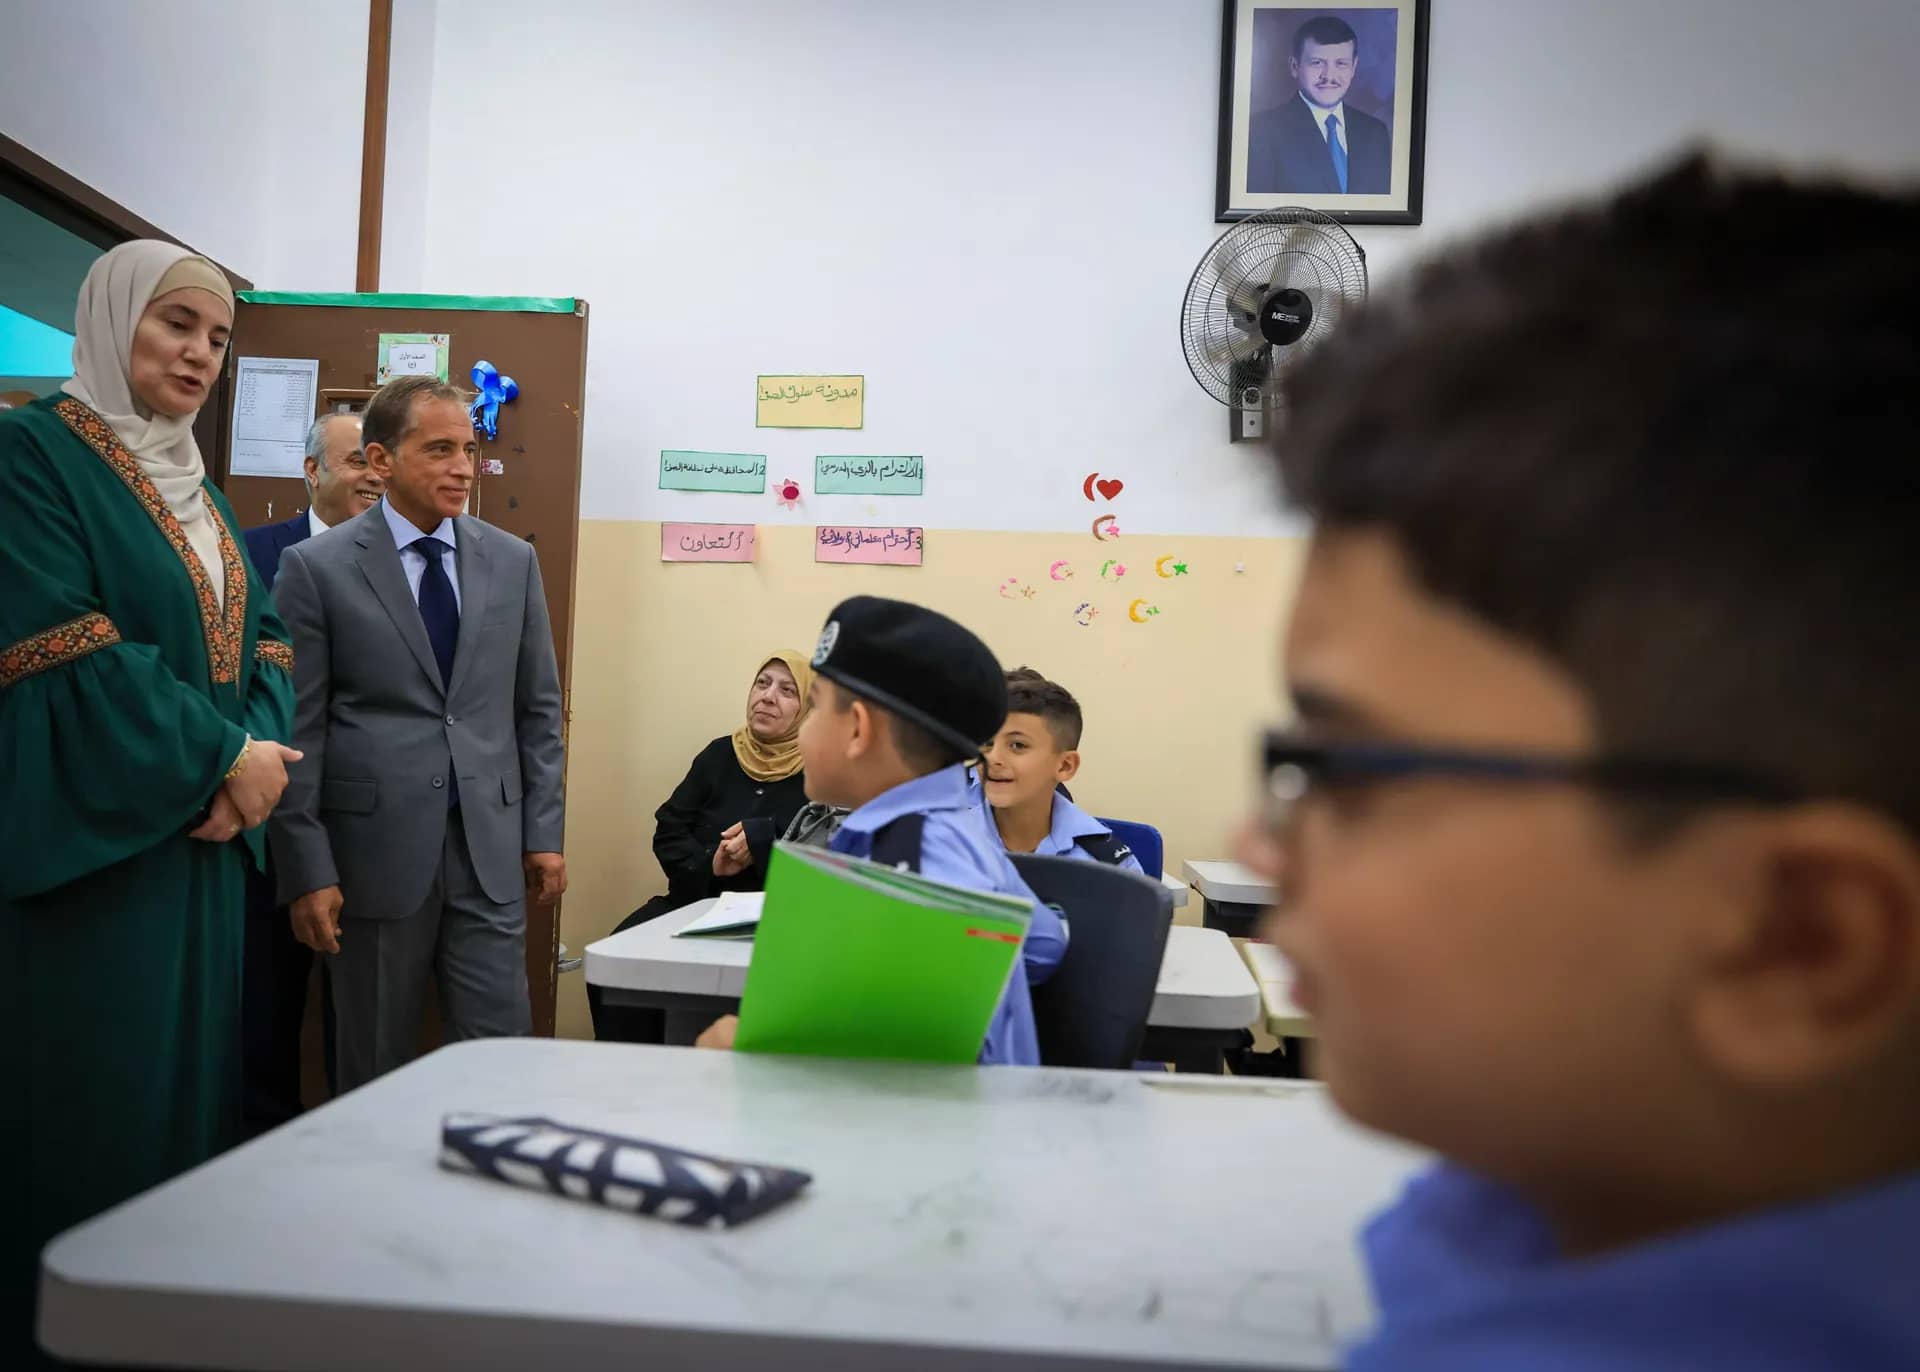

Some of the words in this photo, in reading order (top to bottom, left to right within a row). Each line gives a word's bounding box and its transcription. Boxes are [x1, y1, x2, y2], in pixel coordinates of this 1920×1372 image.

[785, 384, 814, 404] سلوك
[815, 384, 858, 402] مدونة
[820, 459, 850, 479] المدرسي
[850, 459, 878, 477] بالزي
[679, 530, 744, 553] التعاون
